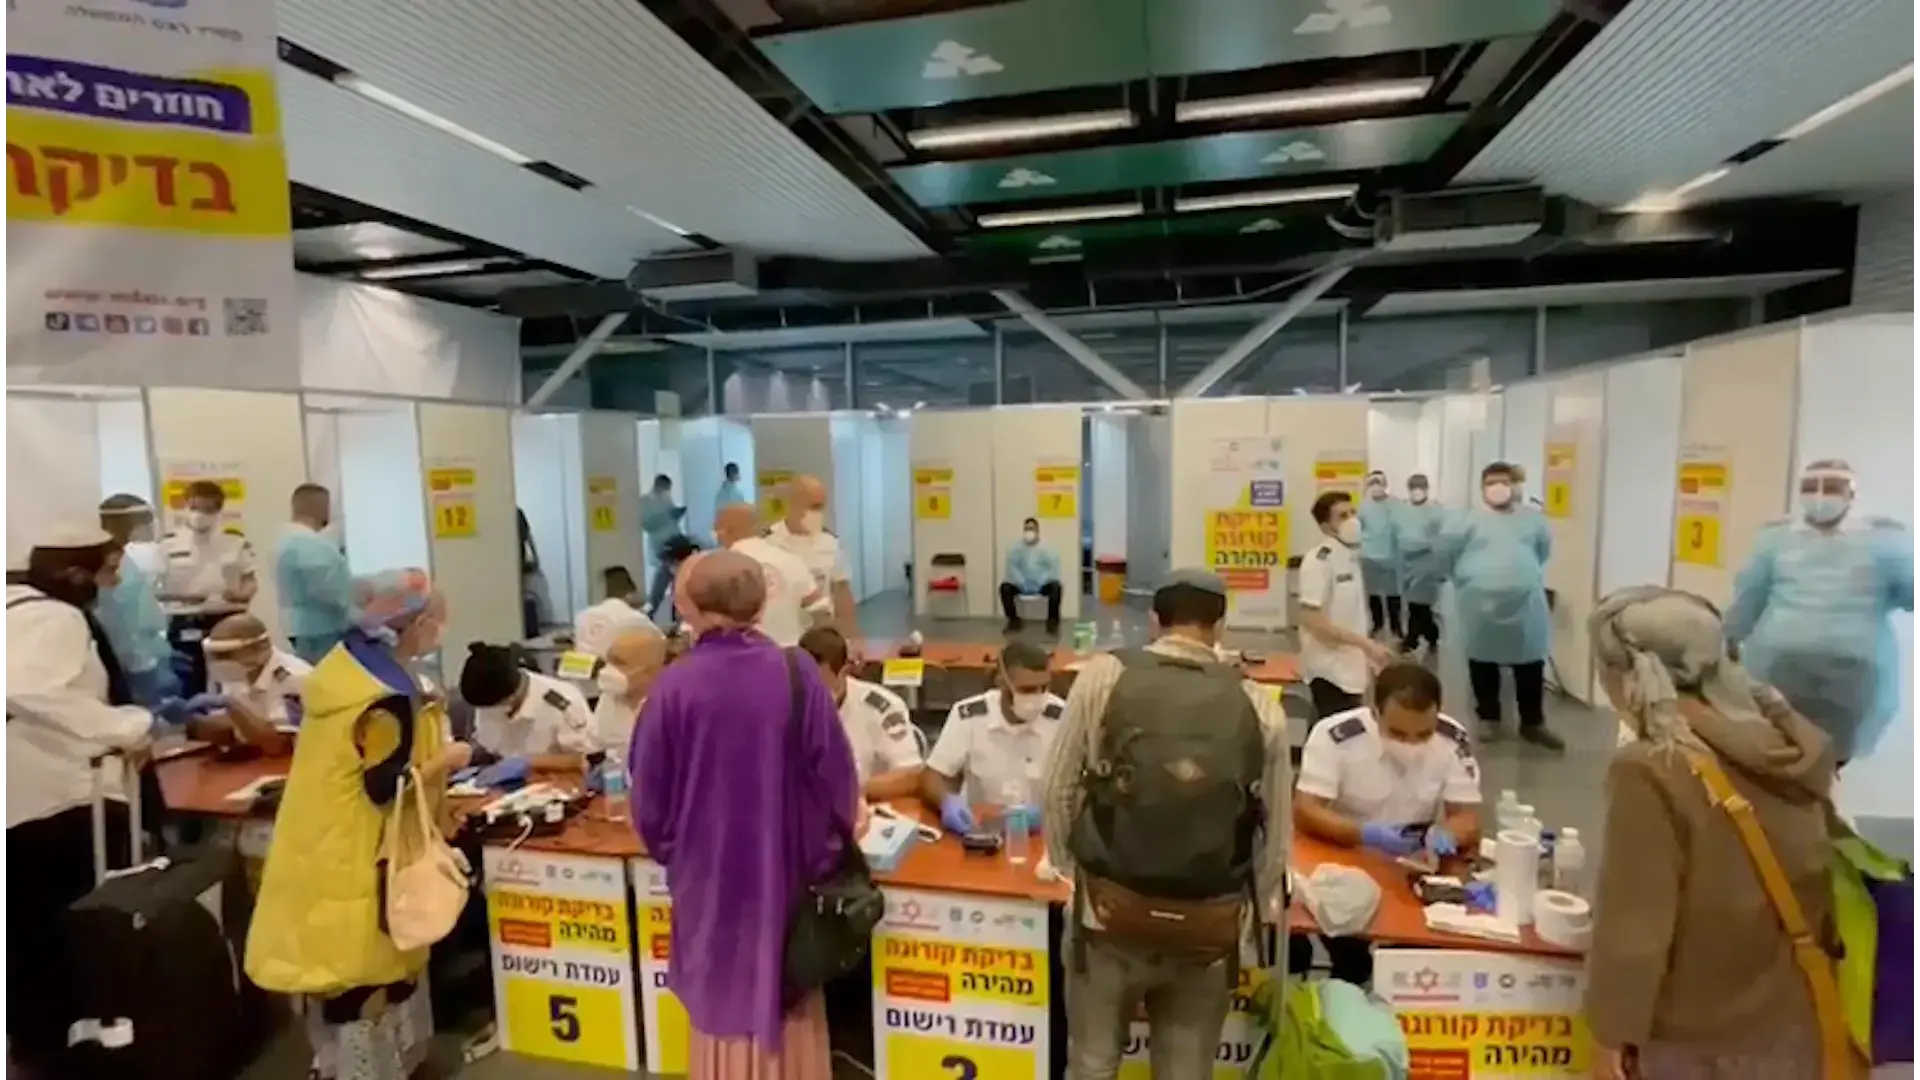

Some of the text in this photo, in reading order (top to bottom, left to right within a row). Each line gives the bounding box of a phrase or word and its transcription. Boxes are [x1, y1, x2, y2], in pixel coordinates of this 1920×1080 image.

[95, 83, 225, 121] חוזרים
[1050, 494, 1063, 511] 7
[443, 506, 467, 528] 12
[1691, 521, 1704, 550] 3
[559, 920, 616, 943] מהירה
[886, 936, 1035, 971] בדיקת קורונה
[501, 953, 621, 987] עמדת רישום
[962, 971, 1034, 996] מהירה
[549, 994, 581, 1043] 5
[886, 1006, 1036, 1045] עמדת רישום
[1485, 1014, 1573, 1038] בדיקת
[1484, 1043, 1573, 1066] מהירה
